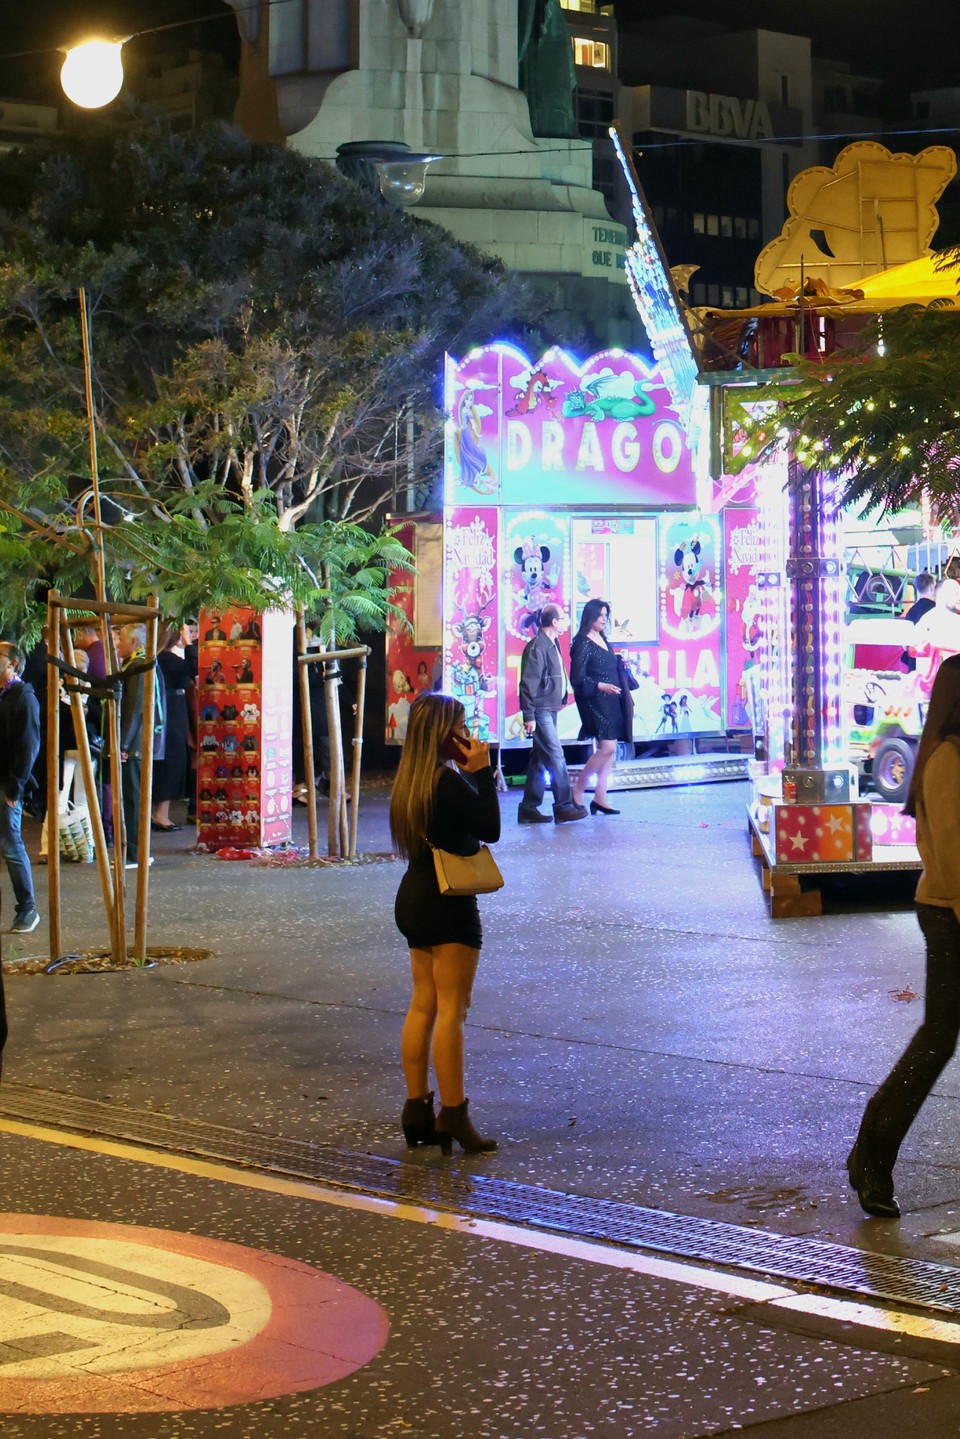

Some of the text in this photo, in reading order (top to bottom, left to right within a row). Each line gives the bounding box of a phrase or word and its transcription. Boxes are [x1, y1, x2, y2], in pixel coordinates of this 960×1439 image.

[686, 89, 775, 140] BBVA
[592, 250, 612, 267] QUE
[507, 419, 697, 474] DRAGO
